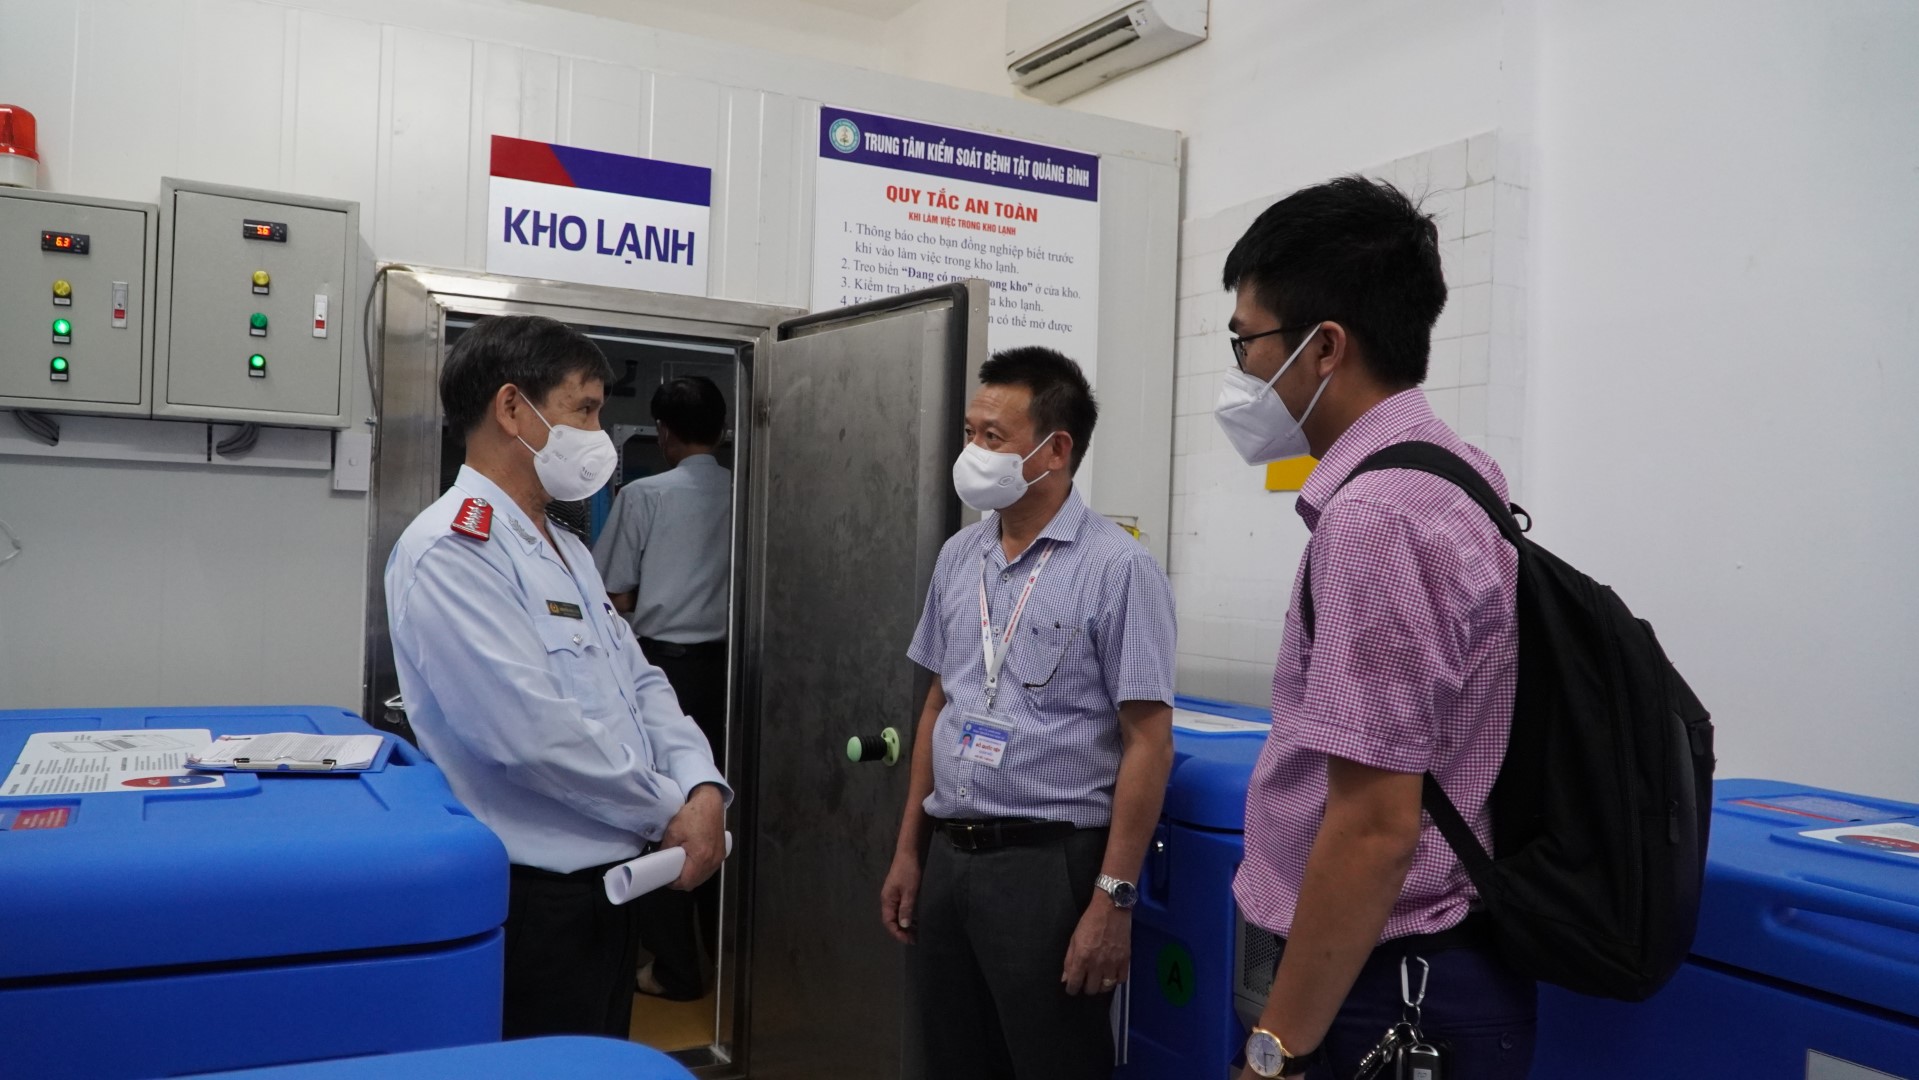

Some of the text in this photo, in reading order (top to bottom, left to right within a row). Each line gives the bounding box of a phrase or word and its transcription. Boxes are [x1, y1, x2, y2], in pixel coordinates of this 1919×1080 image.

[864, 132, 899, 155] TRUNG
[902, 136, 925, 159] TÂM
[927, 137, 954, 164] KIỂM
[956, 147, 982, 169] SOÁT
[984, 150, 1011, 175] BỆNH
[1013, 155, 1030, 180] TẬT
[1032, 158, 1064, 183] QUẢNG
[1066, 164, 1090, 187] BÌNH
[886, 185, 1038, 223] QUY TẮC AN TOÀN
[503, 206, 695, 266] KHO LẠNH
[908, 211, 1016, 236] KHI LÀM VIỆC TRONG KHO LẠNH
[55, 236, 69, 247] 6.3
[844, 221, 1074, 264] 1. Thông báo cho bạn đồng nghiệp biết trước
[855, 241, 1020, 274] khi vào làm việc trong kho lạnh.
[841, 258, 850, 270] 2.
[853, 259, 876, 273] Treo
[878, 261, 899, 276] biển
[937, 272, 948, 282] có
[989, 280, 1007, 292] ong
[1035, 285, 1041, 294] ở
[1044, 285, 1060, 296] cửa
[1062, 286, 1081, 299] kho.
[841, 277, 851, 288] 3.
[854, 277, 883, 292] Kiểm
[887, 284, 900, 294] tra
[999, 297, 1017, 309] kho
[1020, 299, 1044, 312] lạnh.
[996, 314, 1009, 325] có
[1012, 313, 1027, 327] thể
[1029, 319, 1046, 329] mở
[1048, 320, 1073, 334] được
[1168, 960, 1184, 992] A
